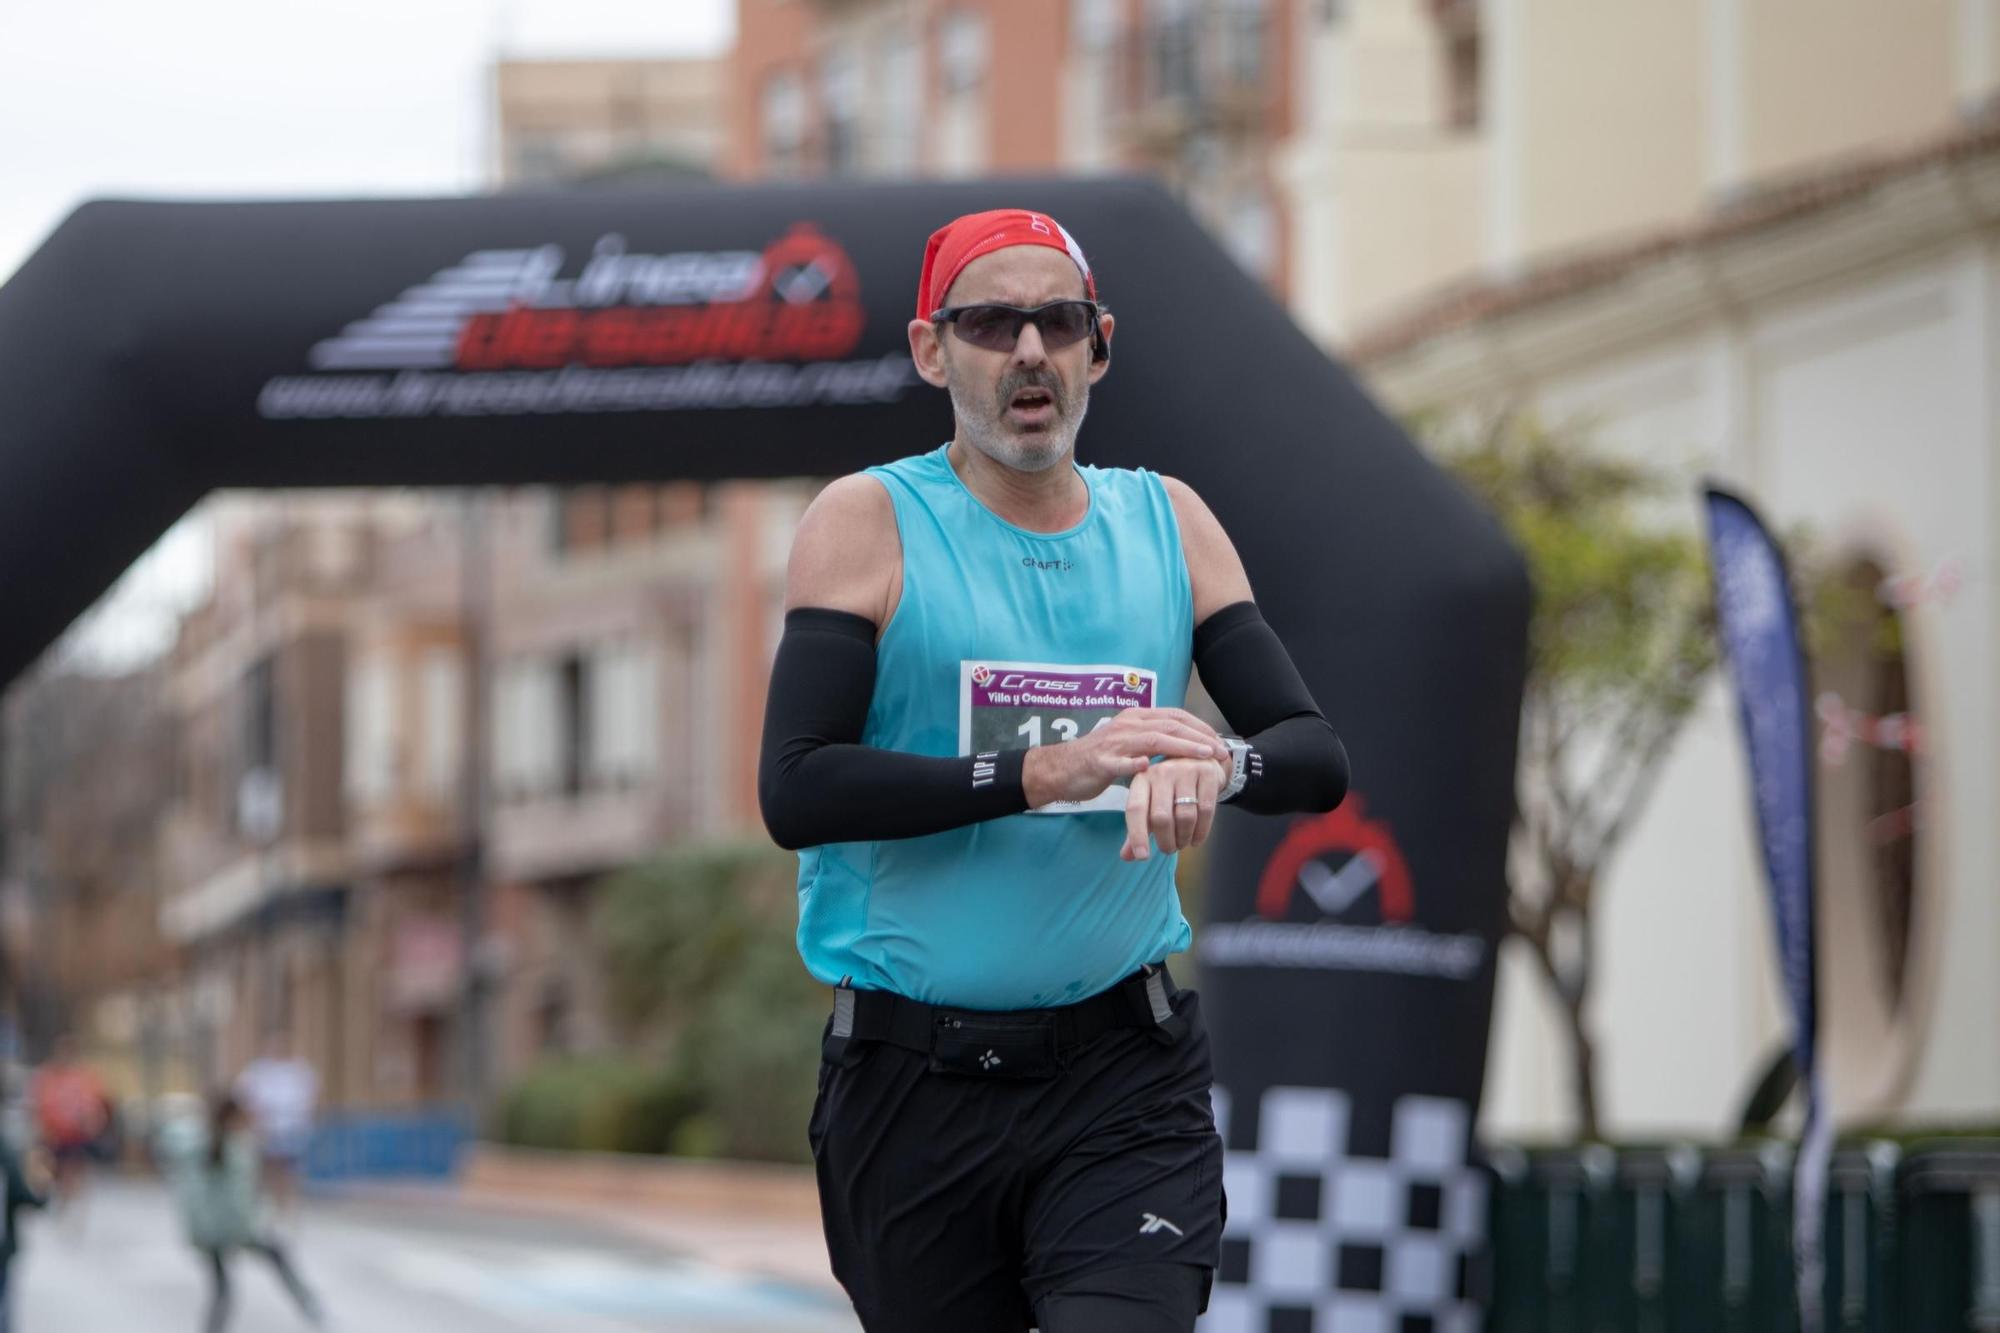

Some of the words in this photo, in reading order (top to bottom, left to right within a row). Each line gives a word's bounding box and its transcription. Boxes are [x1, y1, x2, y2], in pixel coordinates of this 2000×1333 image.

[1000, 674, 1081, 692] Cross
[988, 692, 1011, 704] Villa
[1013, 694, 1020, 706] y
[1021, 692, 1068, 706] Condado
[1069, 696, 1083, 706] de
[1085, 694, 1115, 706] Santa
